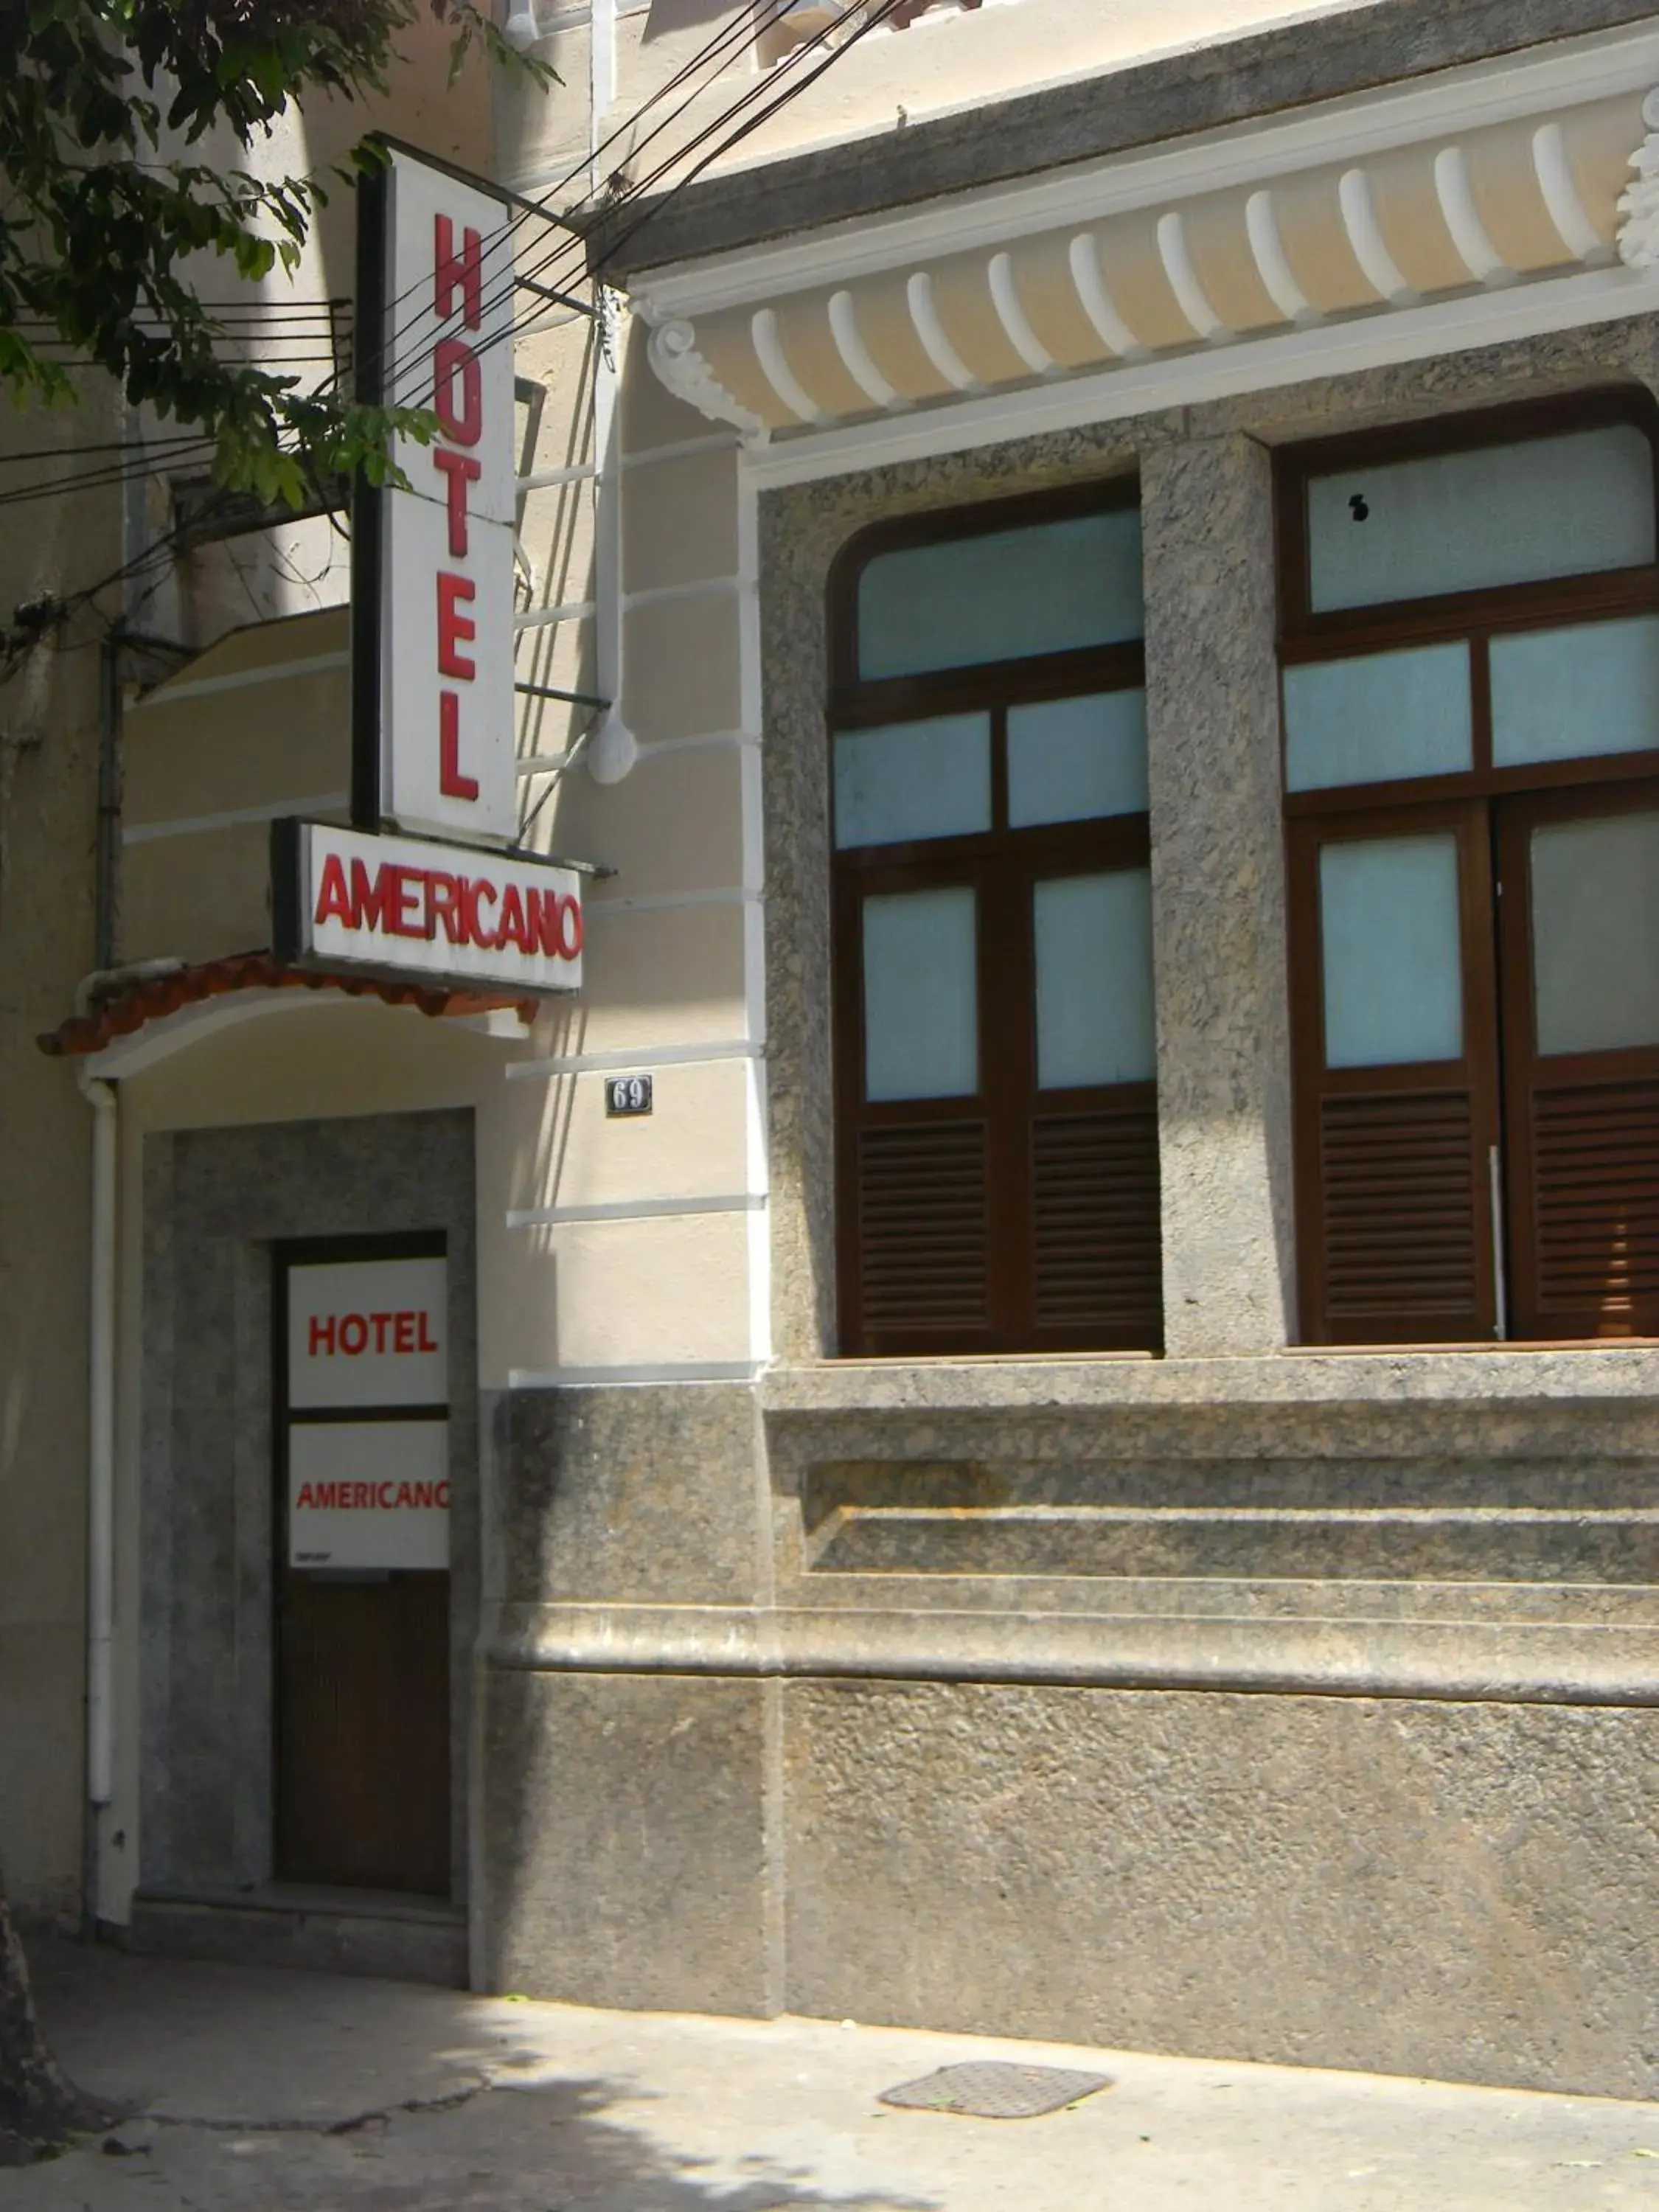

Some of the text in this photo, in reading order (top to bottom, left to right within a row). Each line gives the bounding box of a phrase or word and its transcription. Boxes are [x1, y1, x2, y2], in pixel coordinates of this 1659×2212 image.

[432, 212, 481, 803] HOTEL
[314, 852, 584, 961] AMERICANO
[613, 1078, 643, 1109] 69
[308, 1310, 439, 1357] HOTEL
